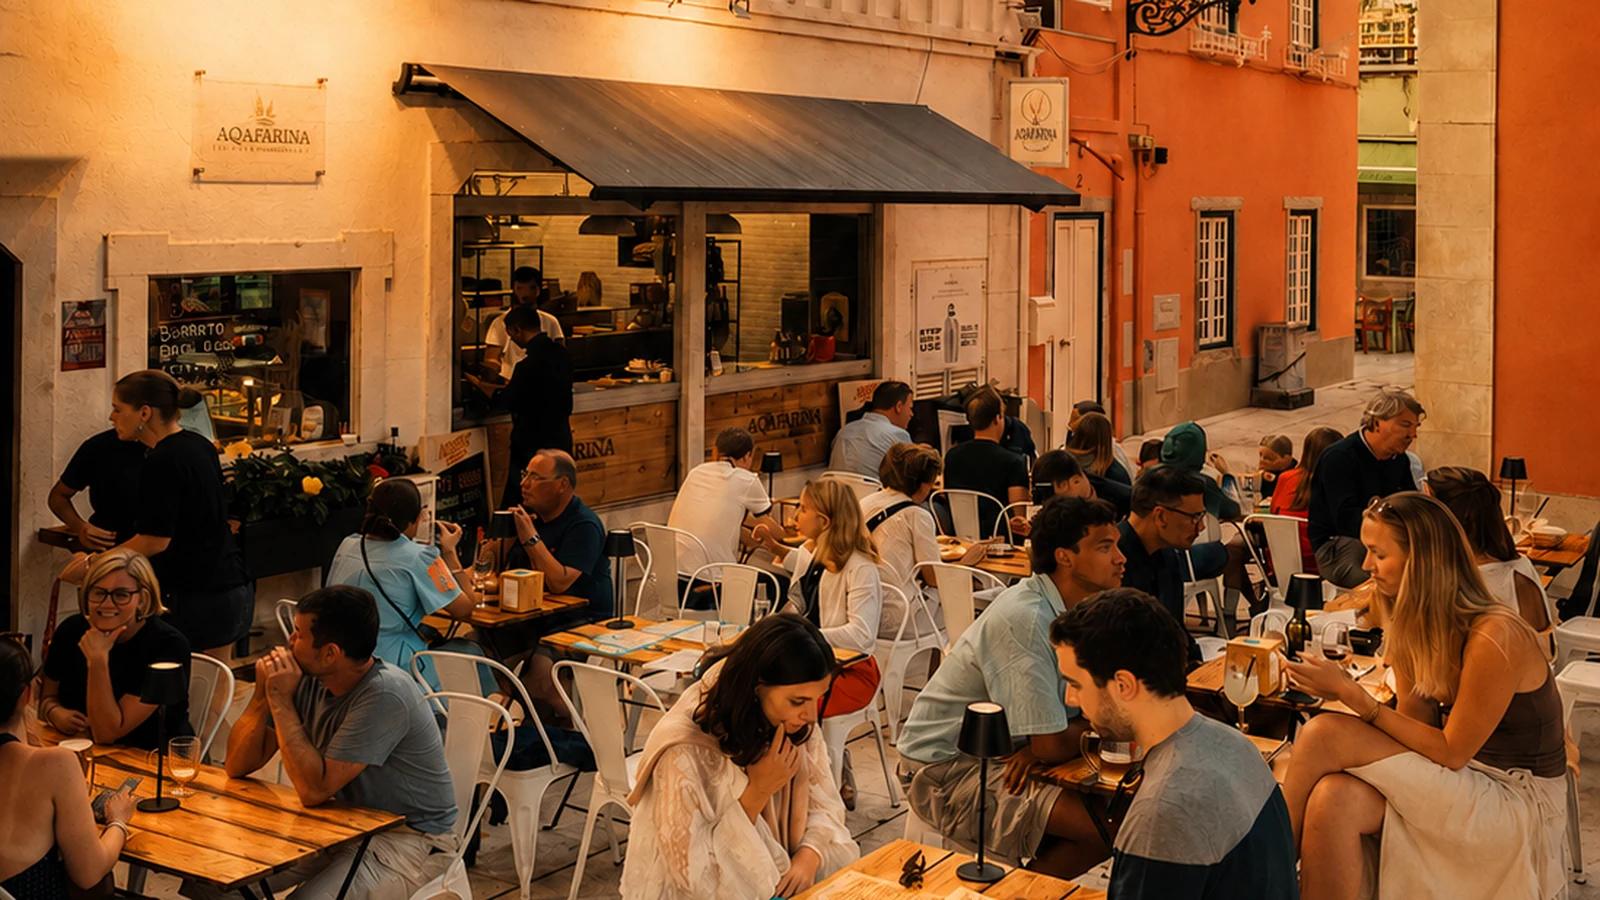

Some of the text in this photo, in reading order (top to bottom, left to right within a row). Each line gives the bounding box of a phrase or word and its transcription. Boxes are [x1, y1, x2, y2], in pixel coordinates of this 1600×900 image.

[216, 126, 311, 146] AQAFARINA
[1075, 173, 1083, 189] 2
[919, 342, 942, 352] USE
